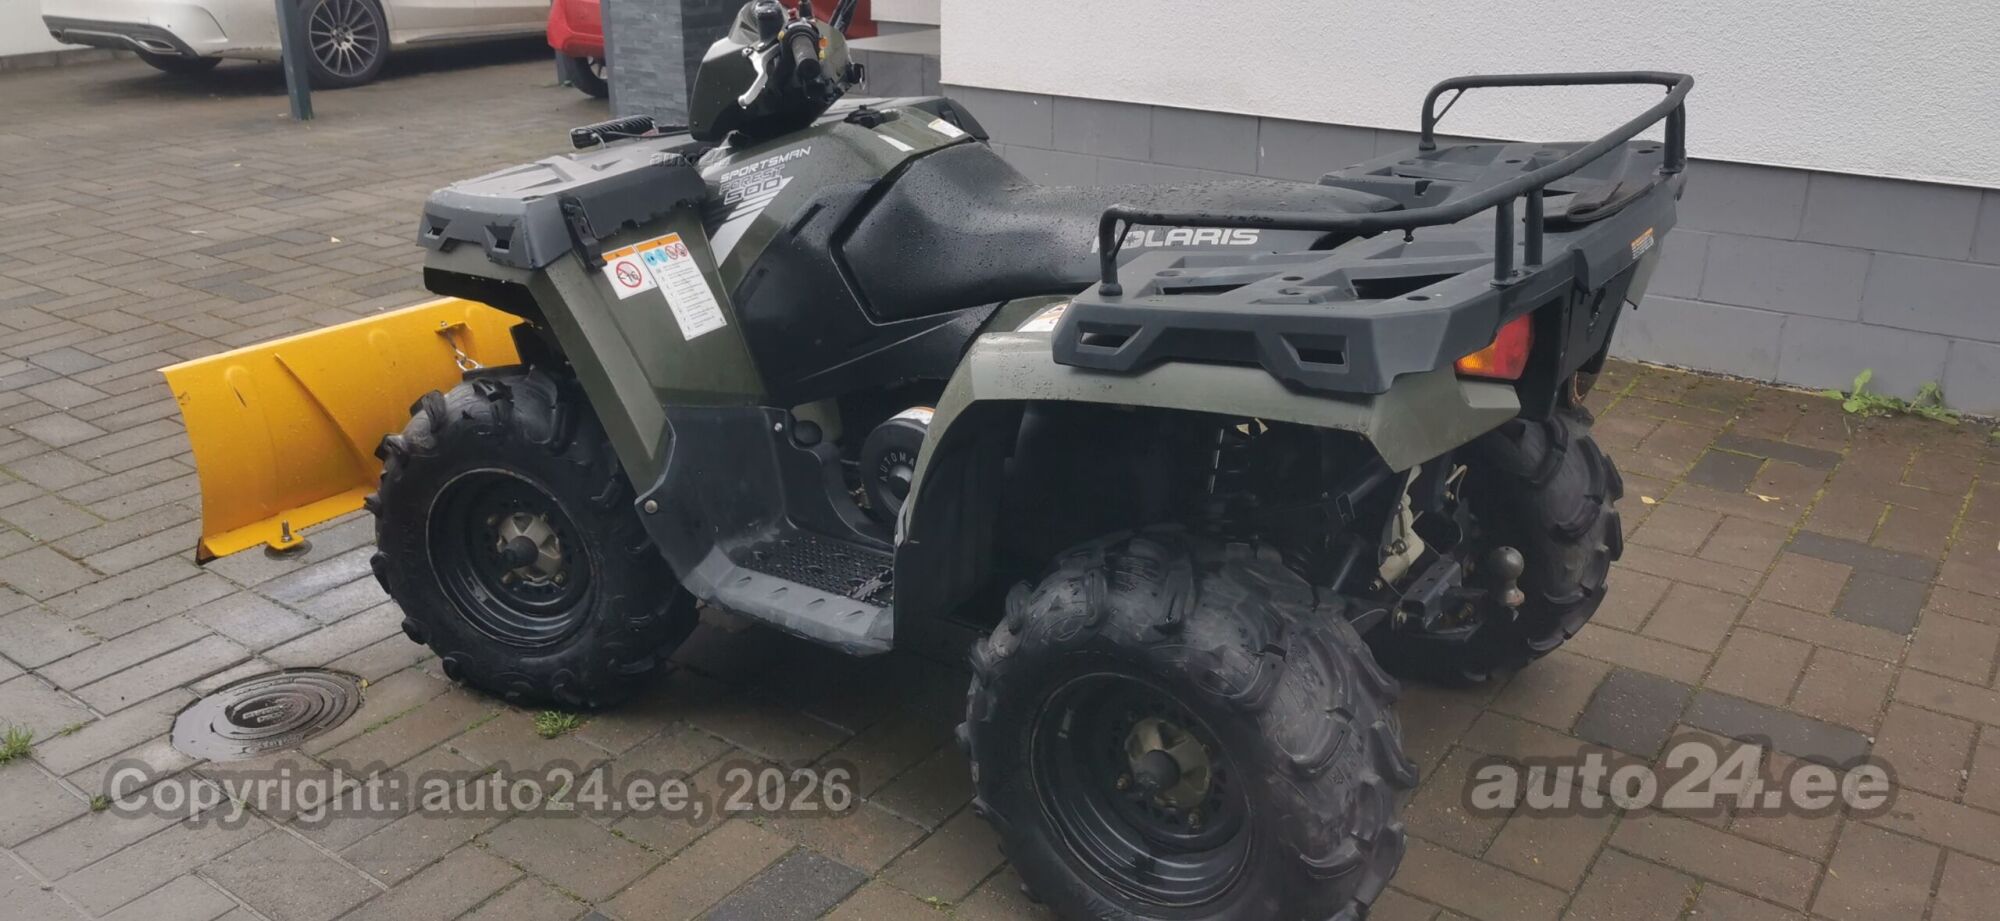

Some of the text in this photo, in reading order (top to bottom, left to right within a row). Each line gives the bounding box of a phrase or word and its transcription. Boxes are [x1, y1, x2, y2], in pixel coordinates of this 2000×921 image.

[719, 145, 811, 184] SPORTSMAN
[719, 163, 786, 195] FOREST
[725, 175, 782, 204] 500
[1091, 228, 1260, 253] OLARIS
